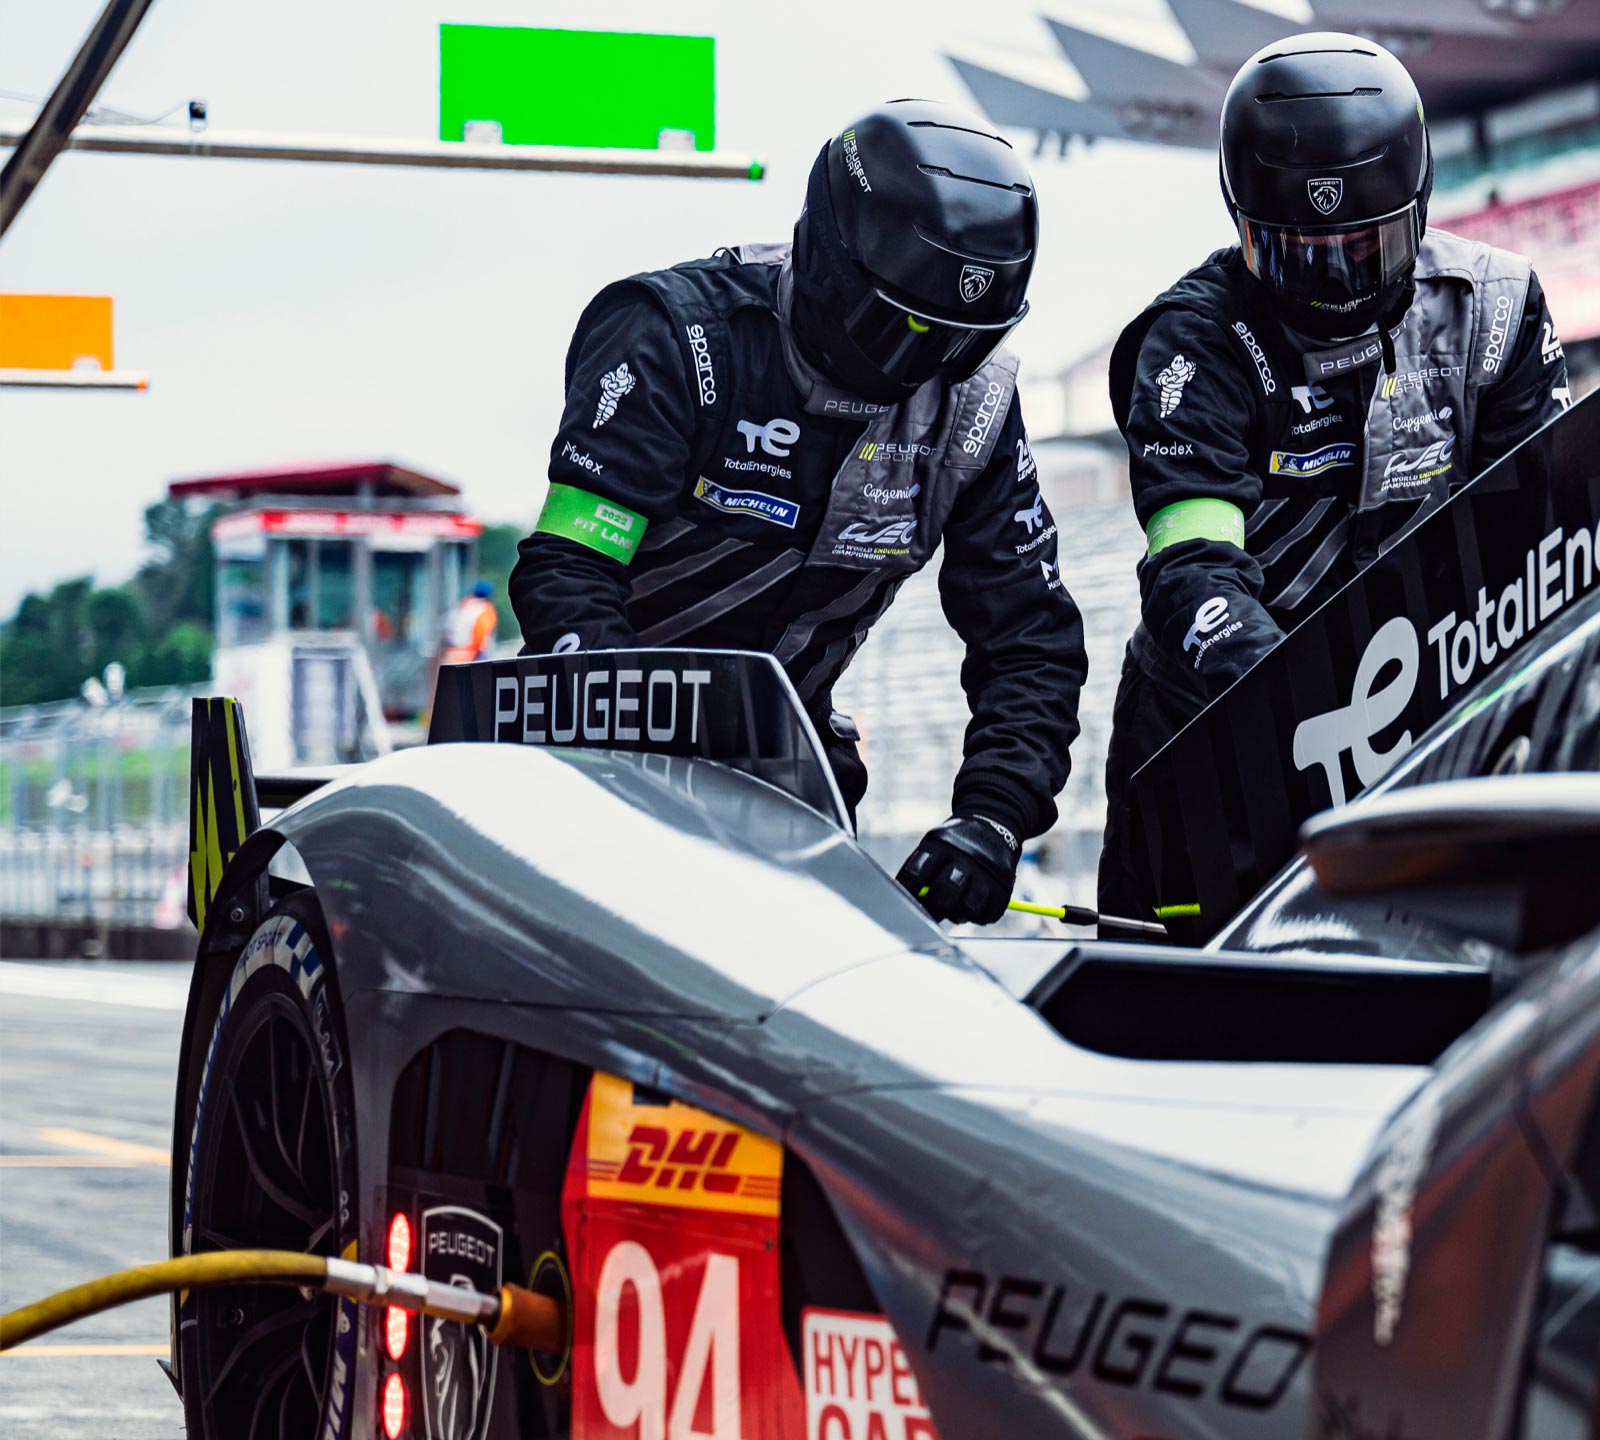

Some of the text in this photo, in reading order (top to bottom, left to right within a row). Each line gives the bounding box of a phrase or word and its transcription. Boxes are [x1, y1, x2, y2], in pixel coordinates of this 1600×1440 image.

[849, 139, 872, 193] PEUGEOT
[687, 323, 717, 406] sparco
[1233, 321, 1276, 396] sparco
[1483, 296, 1513, 374] sparco
[963, 381, 1004, 458] sparco
[724, 457, 792, 480] TotalEnergies
[724, 497, 790, 518] MICHELIN
[494, 669, 712, 744] PEUGEOT
[616, 1124, 742, 1195] DHL
[428, 1230, 496, 1268] PEUGEOT
[594, 1240, 742, 1440] 94
[813, 1330, 928, 1408] HYPE
[926, 1267, 1318, 1415] PEUGEO
